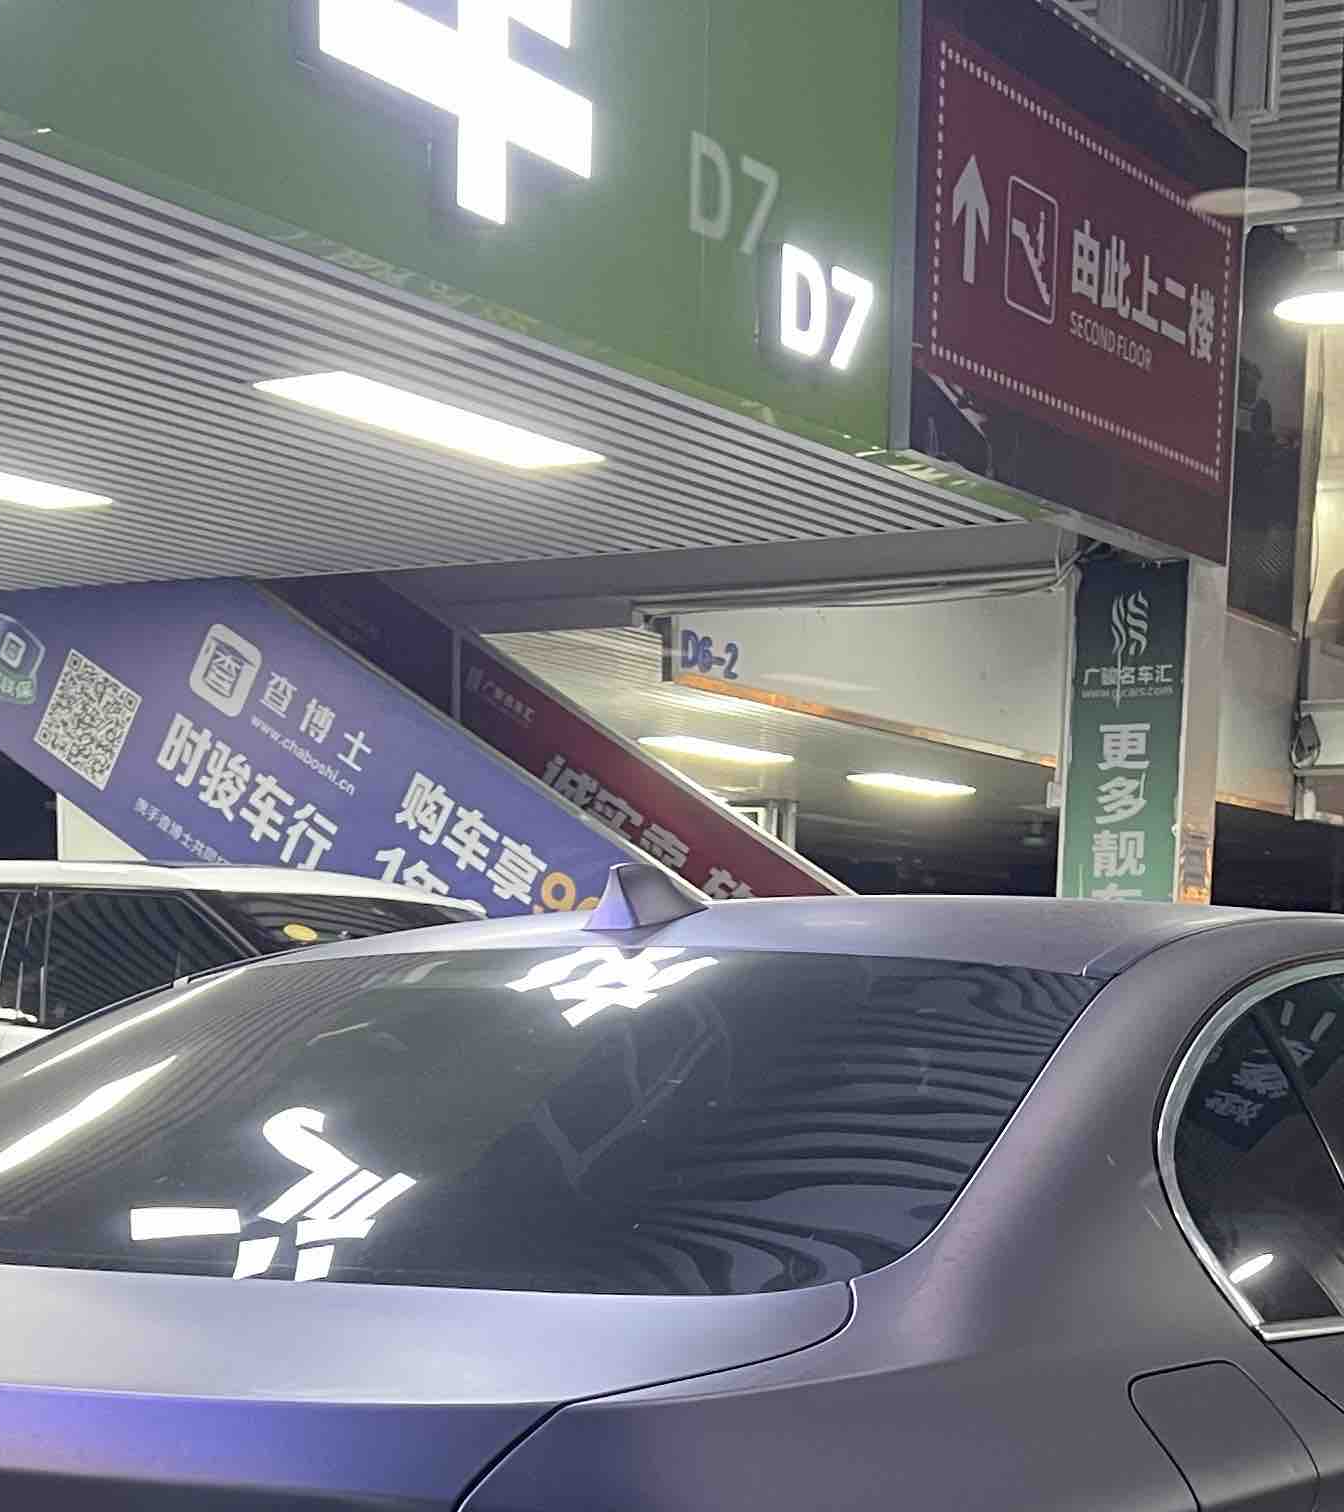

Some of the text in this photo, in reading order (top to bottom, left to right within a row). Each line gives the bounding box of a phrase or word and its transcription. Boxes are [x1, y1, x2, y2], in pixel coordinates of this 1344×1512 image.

[688, 130, 781, 255] D7
[780, 242, 875, 371] D7
[1069, 311, 1154, 372] SECOND FLOOR
[1071, 219, 1216, 364] 由此上二楼
[681, 629, 739, 679] D6-2
[251, 714, 356, 797] www.chaboshi.cn
[258, 671, 373, 773] 查博士
[156, 712, 339, 871] 时骏车行
